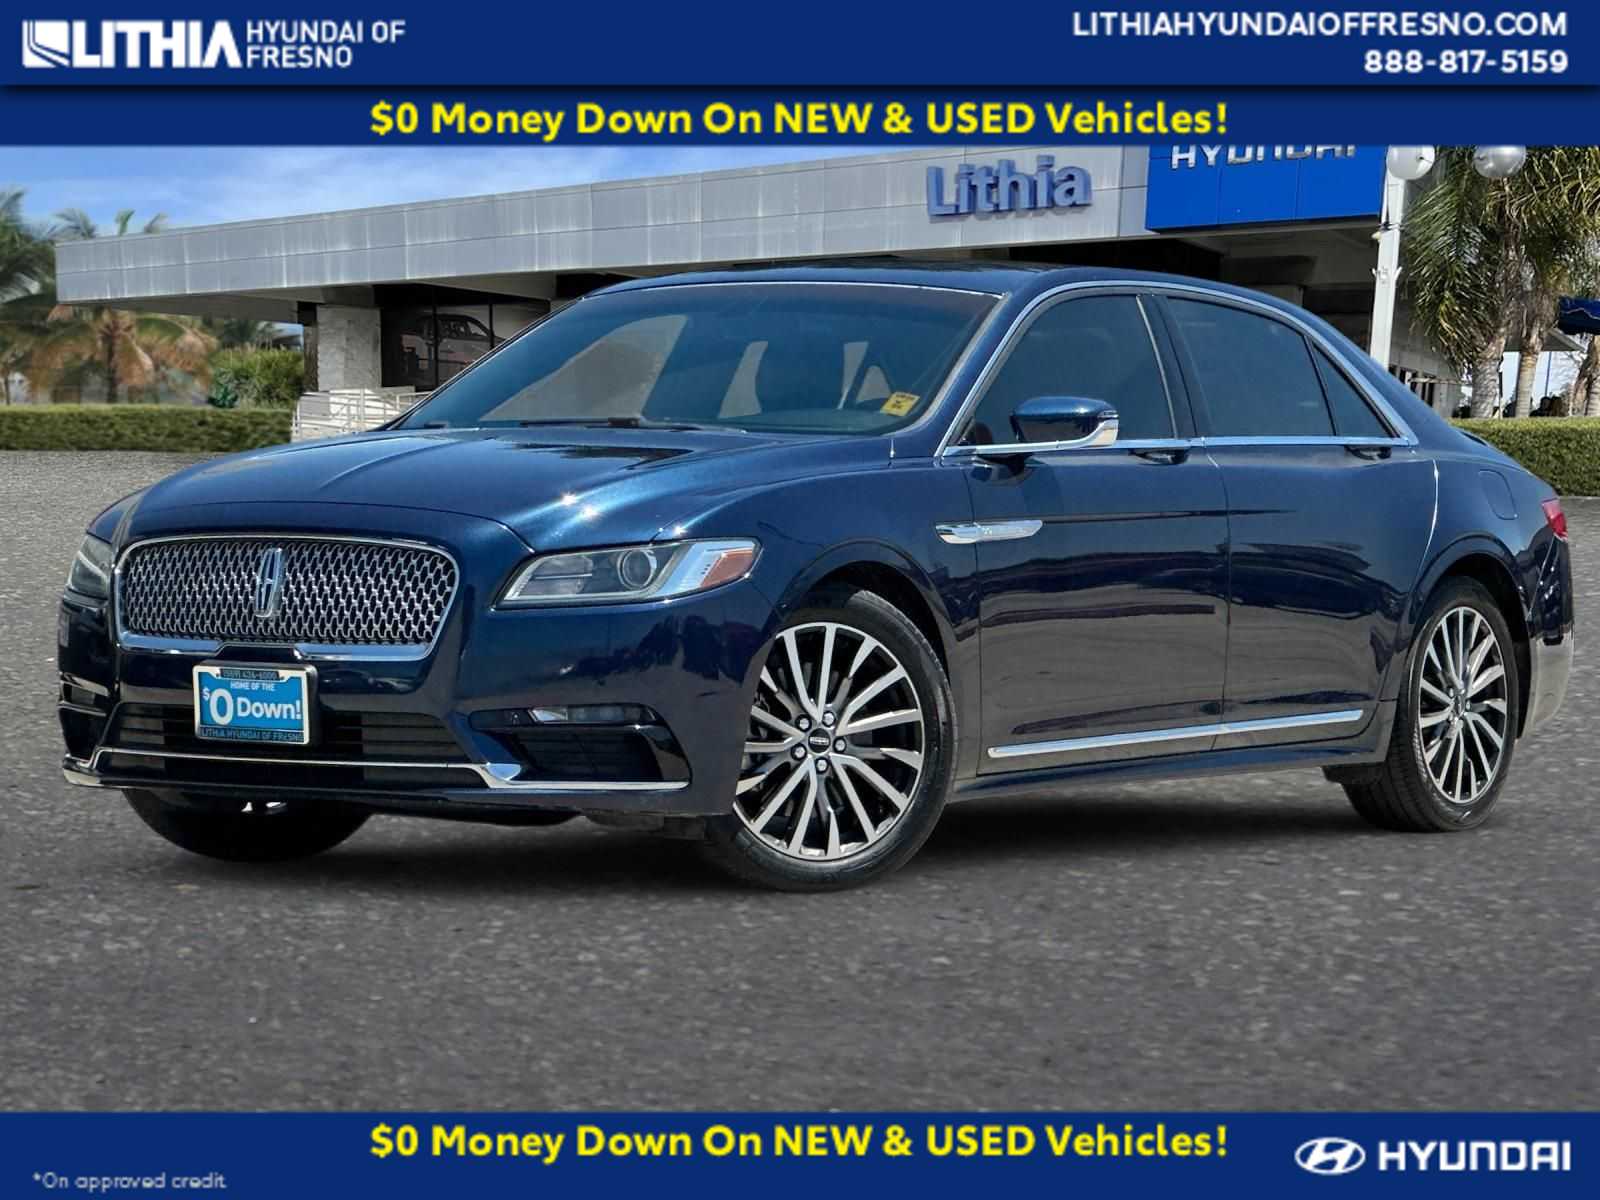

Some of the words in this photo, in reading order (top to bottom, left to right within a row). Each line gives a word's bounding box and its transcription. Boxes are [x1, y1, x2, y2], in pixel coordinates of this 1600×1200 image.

[927, 155, 1092, 216] Lithia
[230, 681, 250, 690] HOME
[251, 681, 261, 690] OF
[262, 682, 275, 692] THE
[236, 697, 302, 720] Down!
